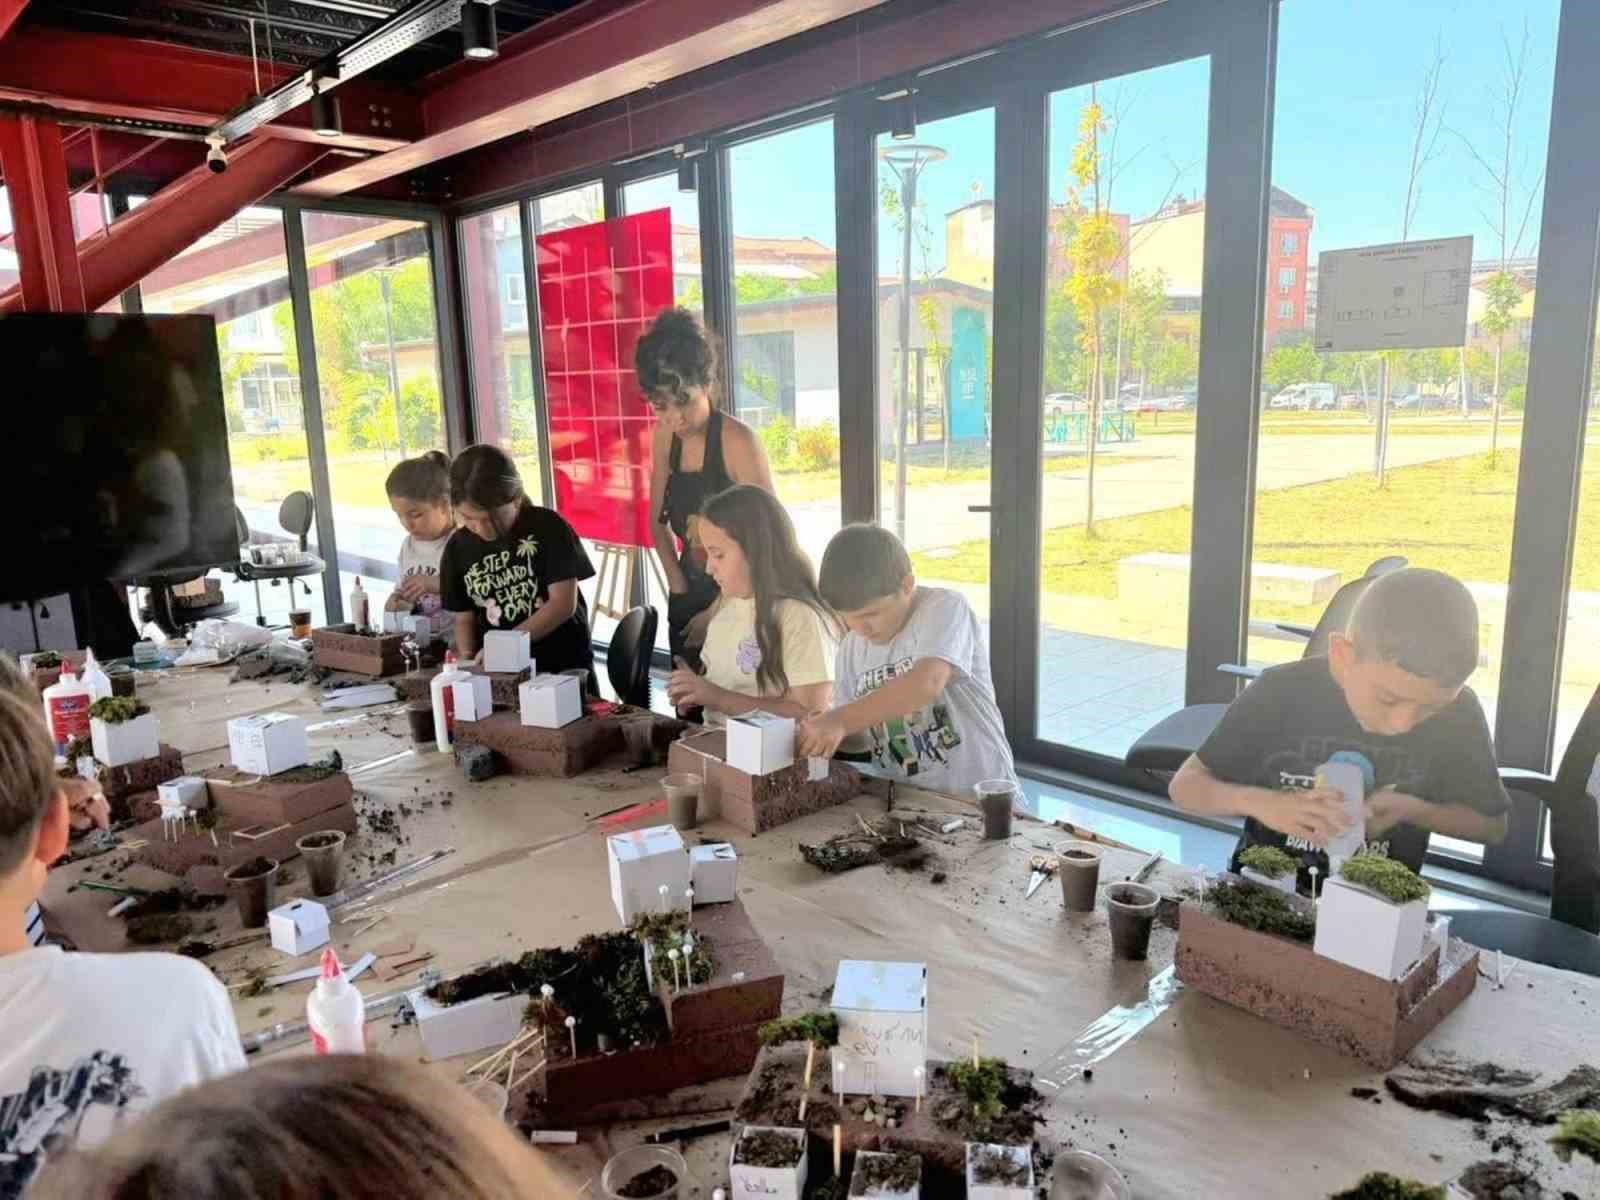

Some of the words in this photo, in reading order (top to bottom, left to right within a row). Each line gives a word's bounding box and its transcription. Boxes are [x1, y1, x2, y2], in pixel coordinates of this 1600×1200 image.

[480, 550, 510, 574] STEP
[473, 566, 527, 597] FORWARD
[495, 577, 538, 605] EVERY
[504, 598, 532, 621] DAY
